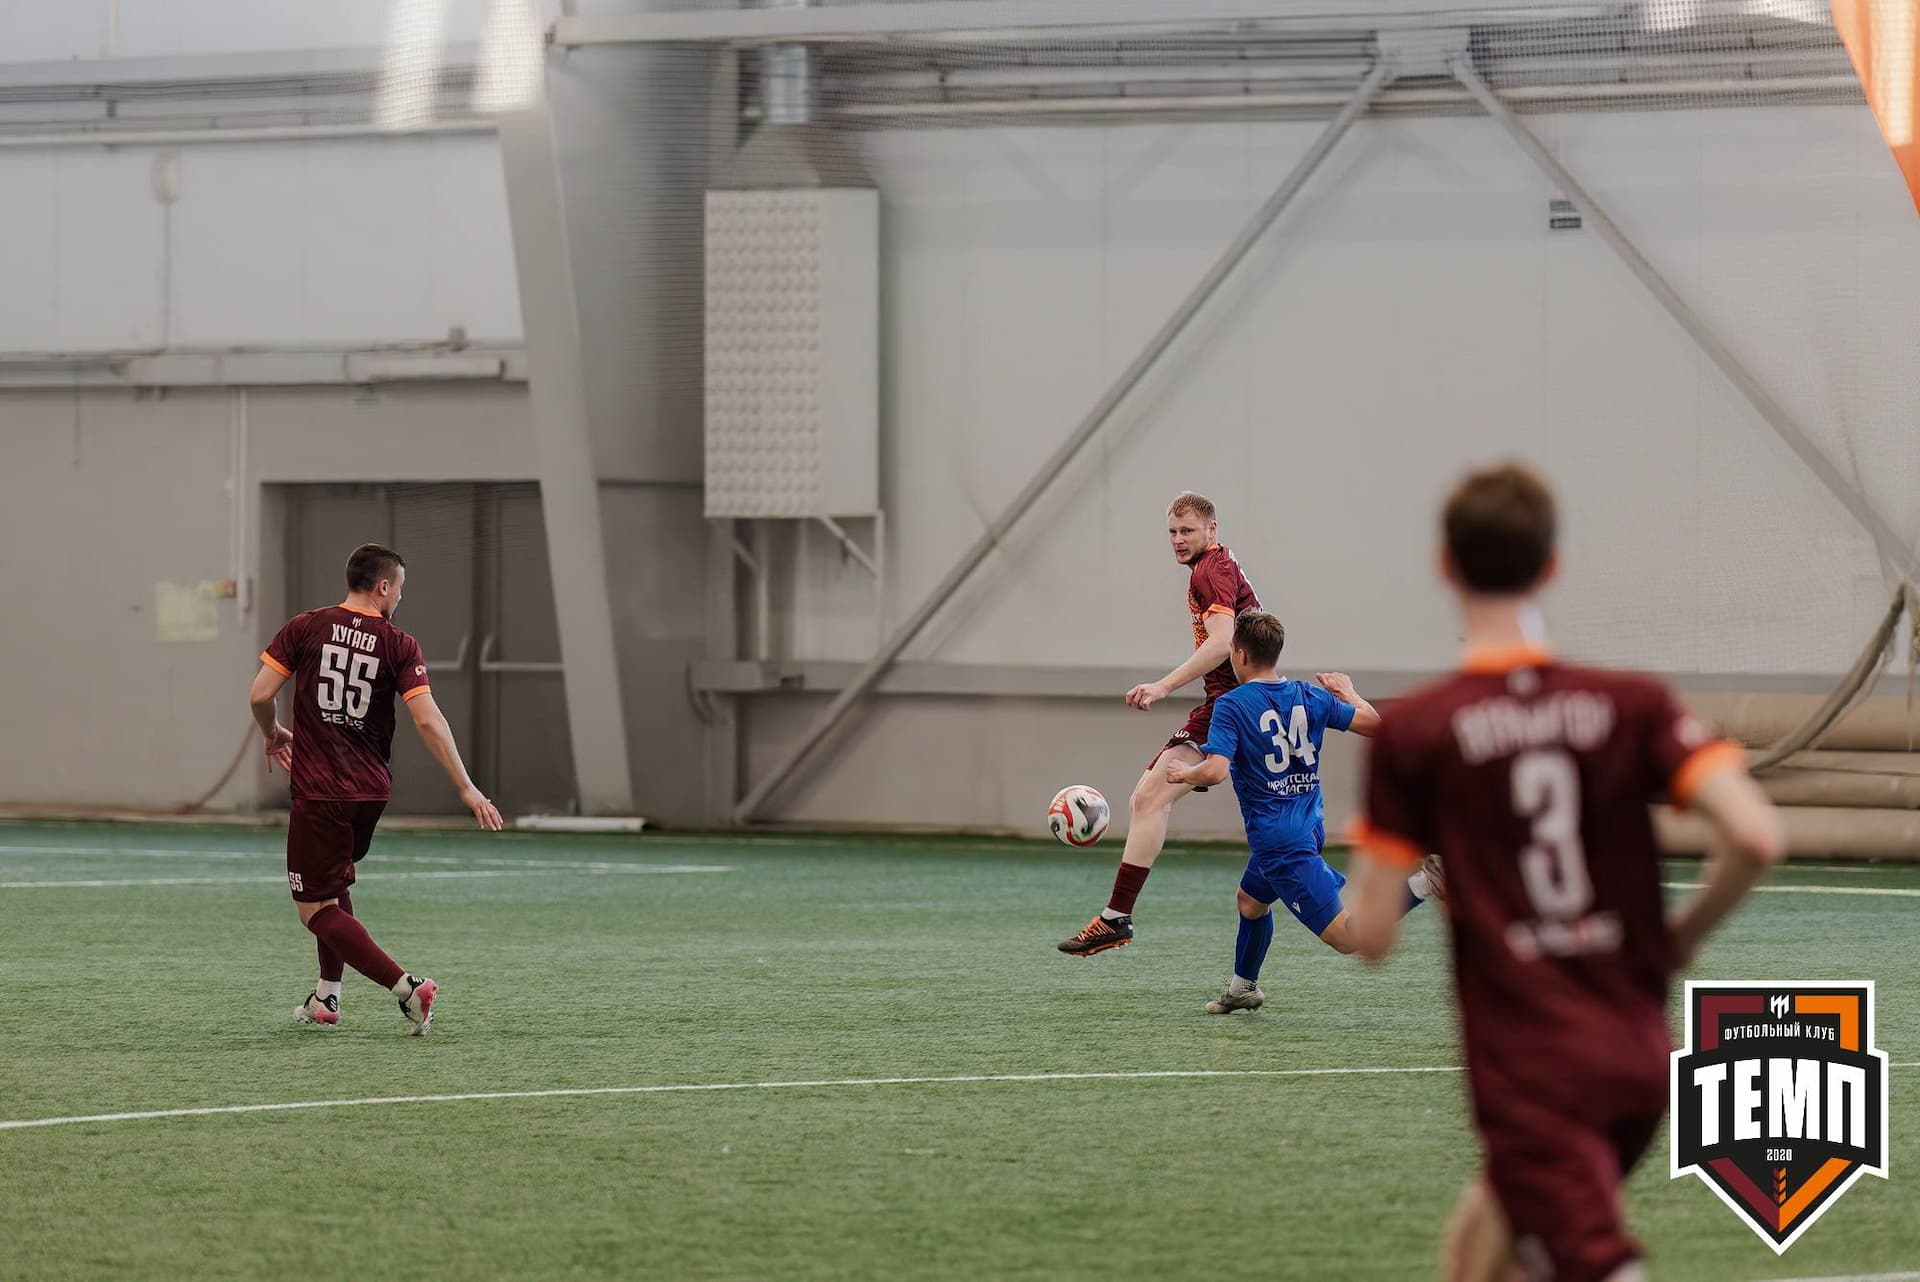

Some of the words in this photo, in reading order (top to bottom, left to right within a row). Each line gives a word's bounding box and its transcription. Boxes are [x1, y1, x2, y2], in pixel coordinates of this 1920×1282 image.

[332, 623, 377, 653] ХУГАЕВ
[318, 643, 380, 719] 55
[1259, 705, 1316, 774] 34
[1511, 750, 1594, 918] 3
[289, 871, 304, 892] 55
